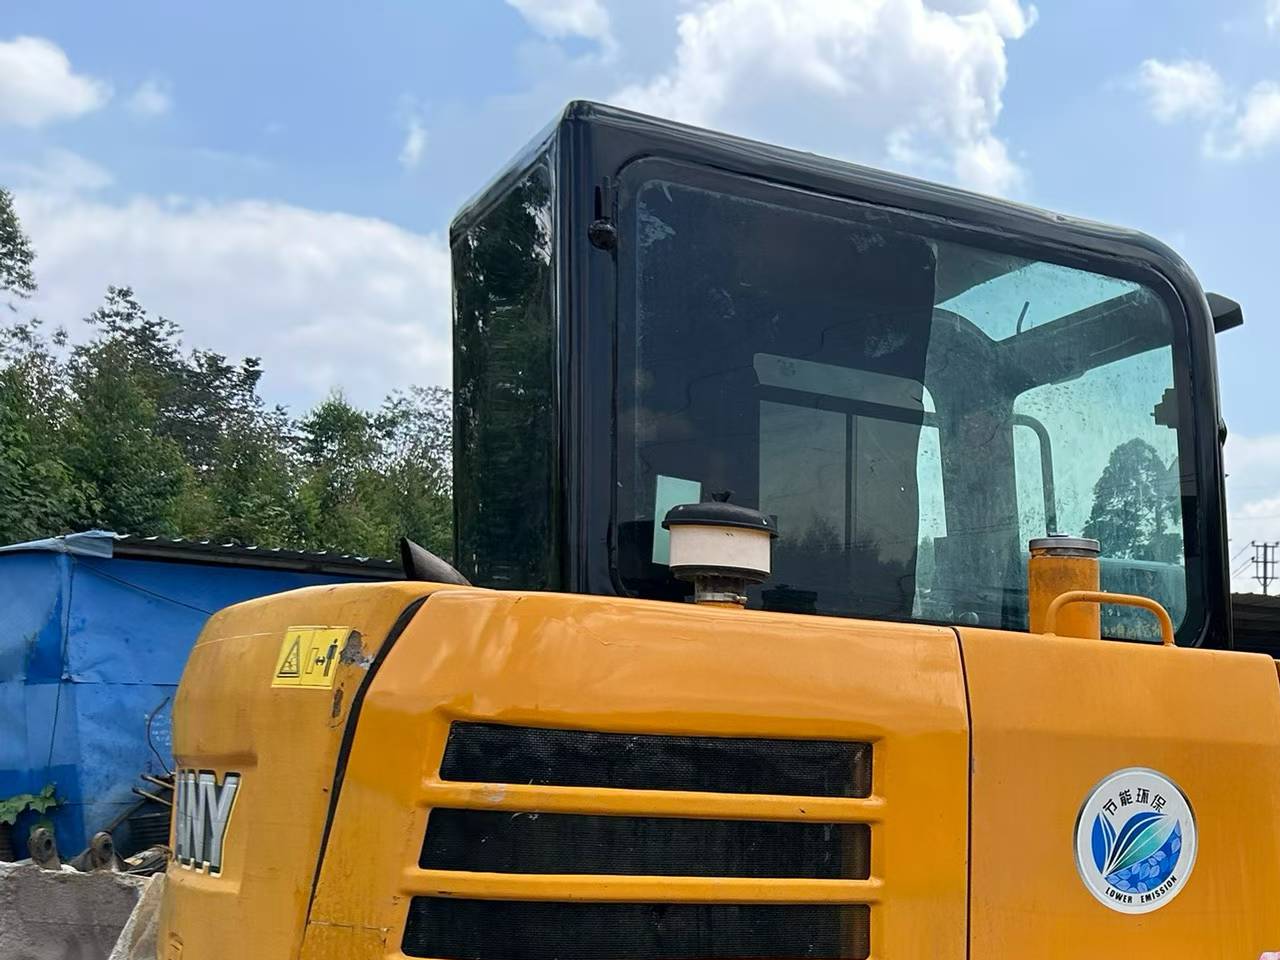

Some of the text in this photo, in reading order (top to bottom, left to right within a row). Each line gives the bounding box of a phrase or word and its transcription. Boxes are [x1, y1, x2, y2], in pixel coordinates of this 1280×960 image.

[1102, 787, 1167, 816] 节能环保
[1105, 875, 1177, 904] LOWER EMISSION
